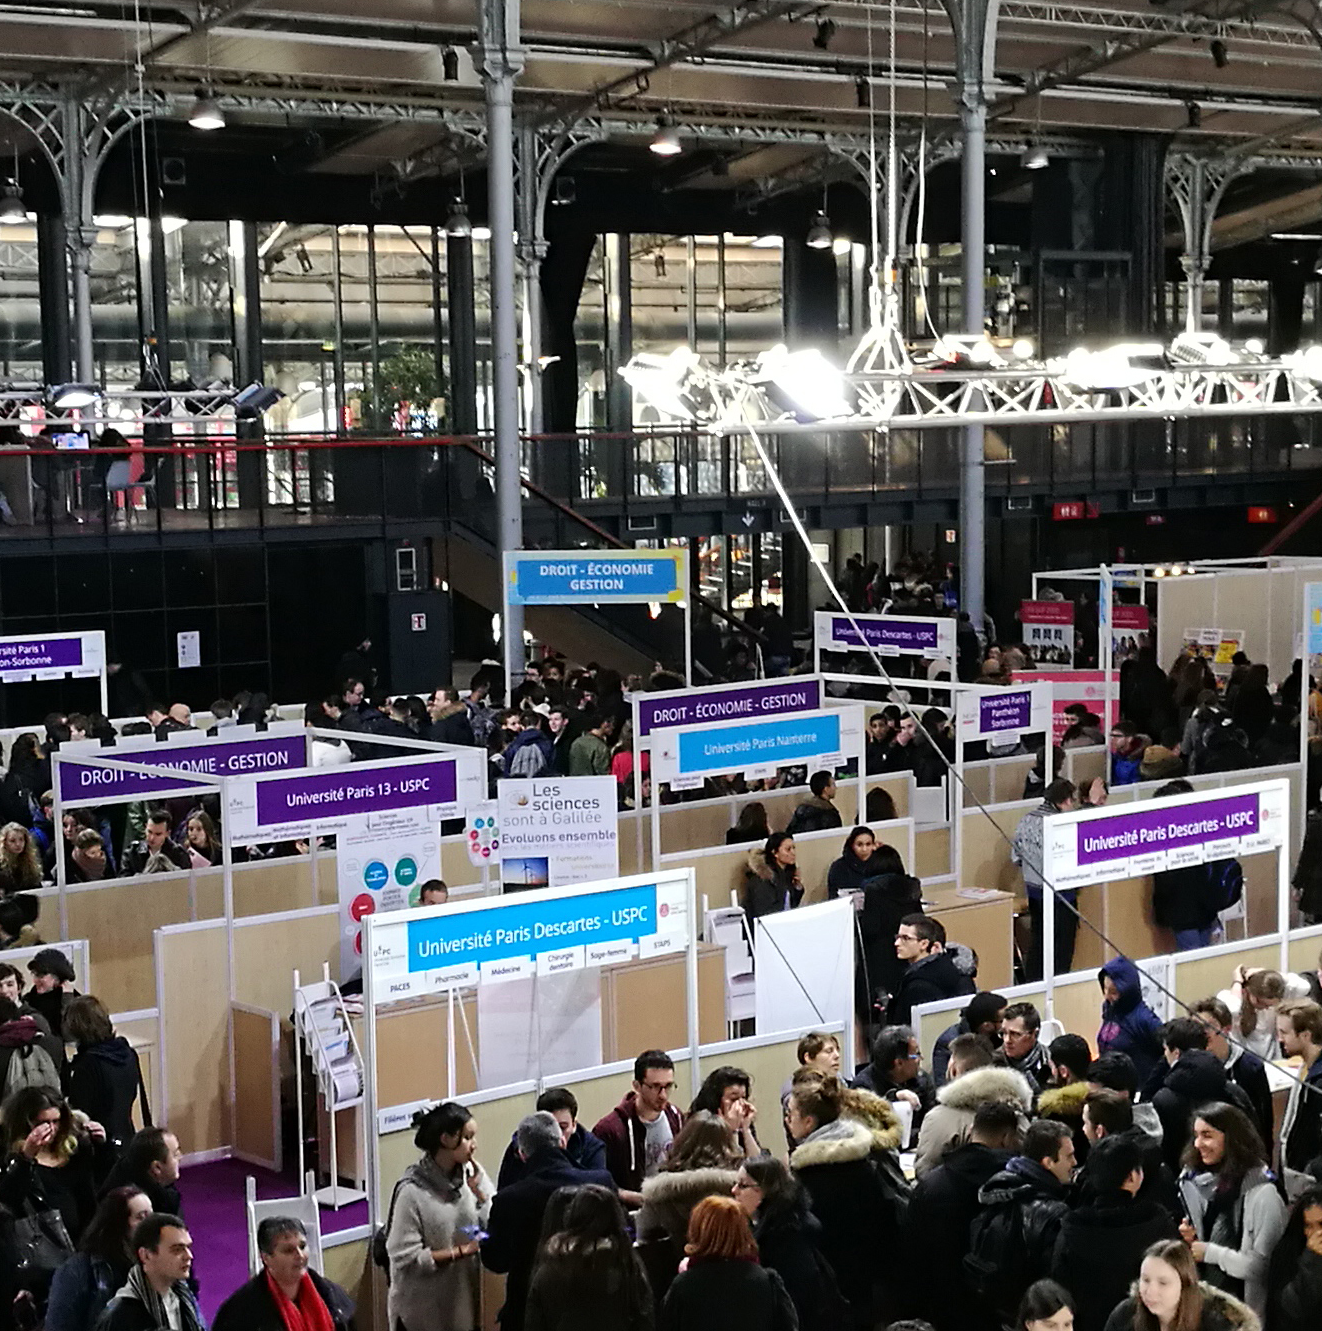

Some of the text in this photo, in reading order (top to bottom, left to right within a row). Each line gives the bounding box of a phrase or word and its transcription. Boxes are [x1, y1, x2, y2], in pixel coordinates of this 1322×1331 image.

[540, 564, 577, 576] DROIT
[587, 562, 654, 575] ÉCONOMIE
[570, 578, 624, 590] GESTION
[18, 645, 39, 655] Paris
[41, 644, 46, 653] 1
[653, 707, 687, 724] DROIT
[695, 700, 754, 719] ÉCONOMIE
[761, 692, 807, 710] GESTION
[703, 733, 818, 755] Université Paris Nanterre
[81, 769, 125, 786] DROIT
[228, 750, 289, 772] GESTION
[286, 789, 344, 807] Université
[346, 785, 375, 800] Paris
[378, 782, 392, 796] 13
[400, 778, 430, 793] USPC
[532, 783, 561, 797] Les
[532, 797, 600, 811] sciences
[503, 810, 602, 827] sont à Galilée
[501, 829, 617, 844] Evoluons ensemble
[1083, 828, 1138, 853] Université
[1140, 825, 1167, 843] Paris
[1168, 818, 1219, 839] Descartes
[1225, 809, 1254, 829] USPC
[418, 930, 493, 958] Université
[495, 926, 531, 945] Paris
[534, 915, 602, 940] Descartes
[611, 904, 649, 926] USPC
[434, 970, 470, 985] Pharmacie
[490, 964, 521, 976] Médecine
[390, 982, 411, 993] PACES
